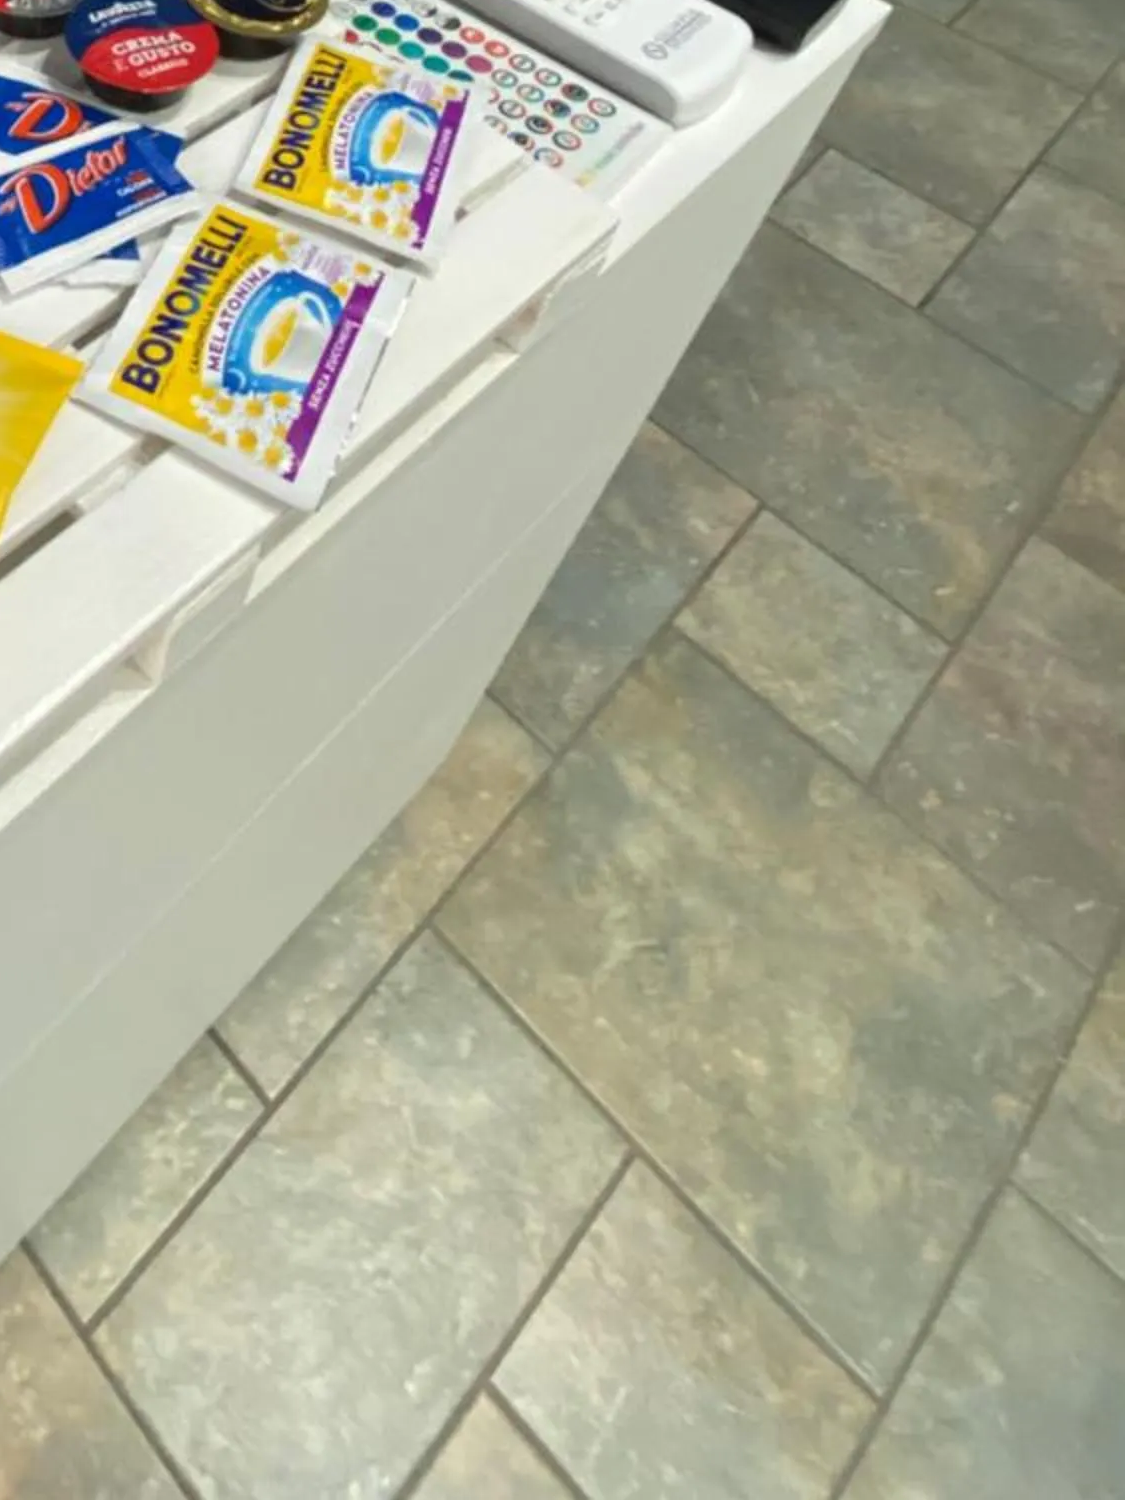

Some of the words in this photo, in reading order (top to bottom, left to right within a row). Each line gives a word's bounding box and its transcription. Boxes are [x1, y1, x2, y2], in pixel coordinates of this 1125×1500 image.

[88, 0, 158, 23] LAVAZZA
[112, 30, 183, 57] CREMA
[127, 40, 196, 67] GUSTO
[262, 48, 348, 191] BONOMELLI
[121, 213, 249, 394] BONOMELLI
[206, 266, 271, 373] MELATONINA
